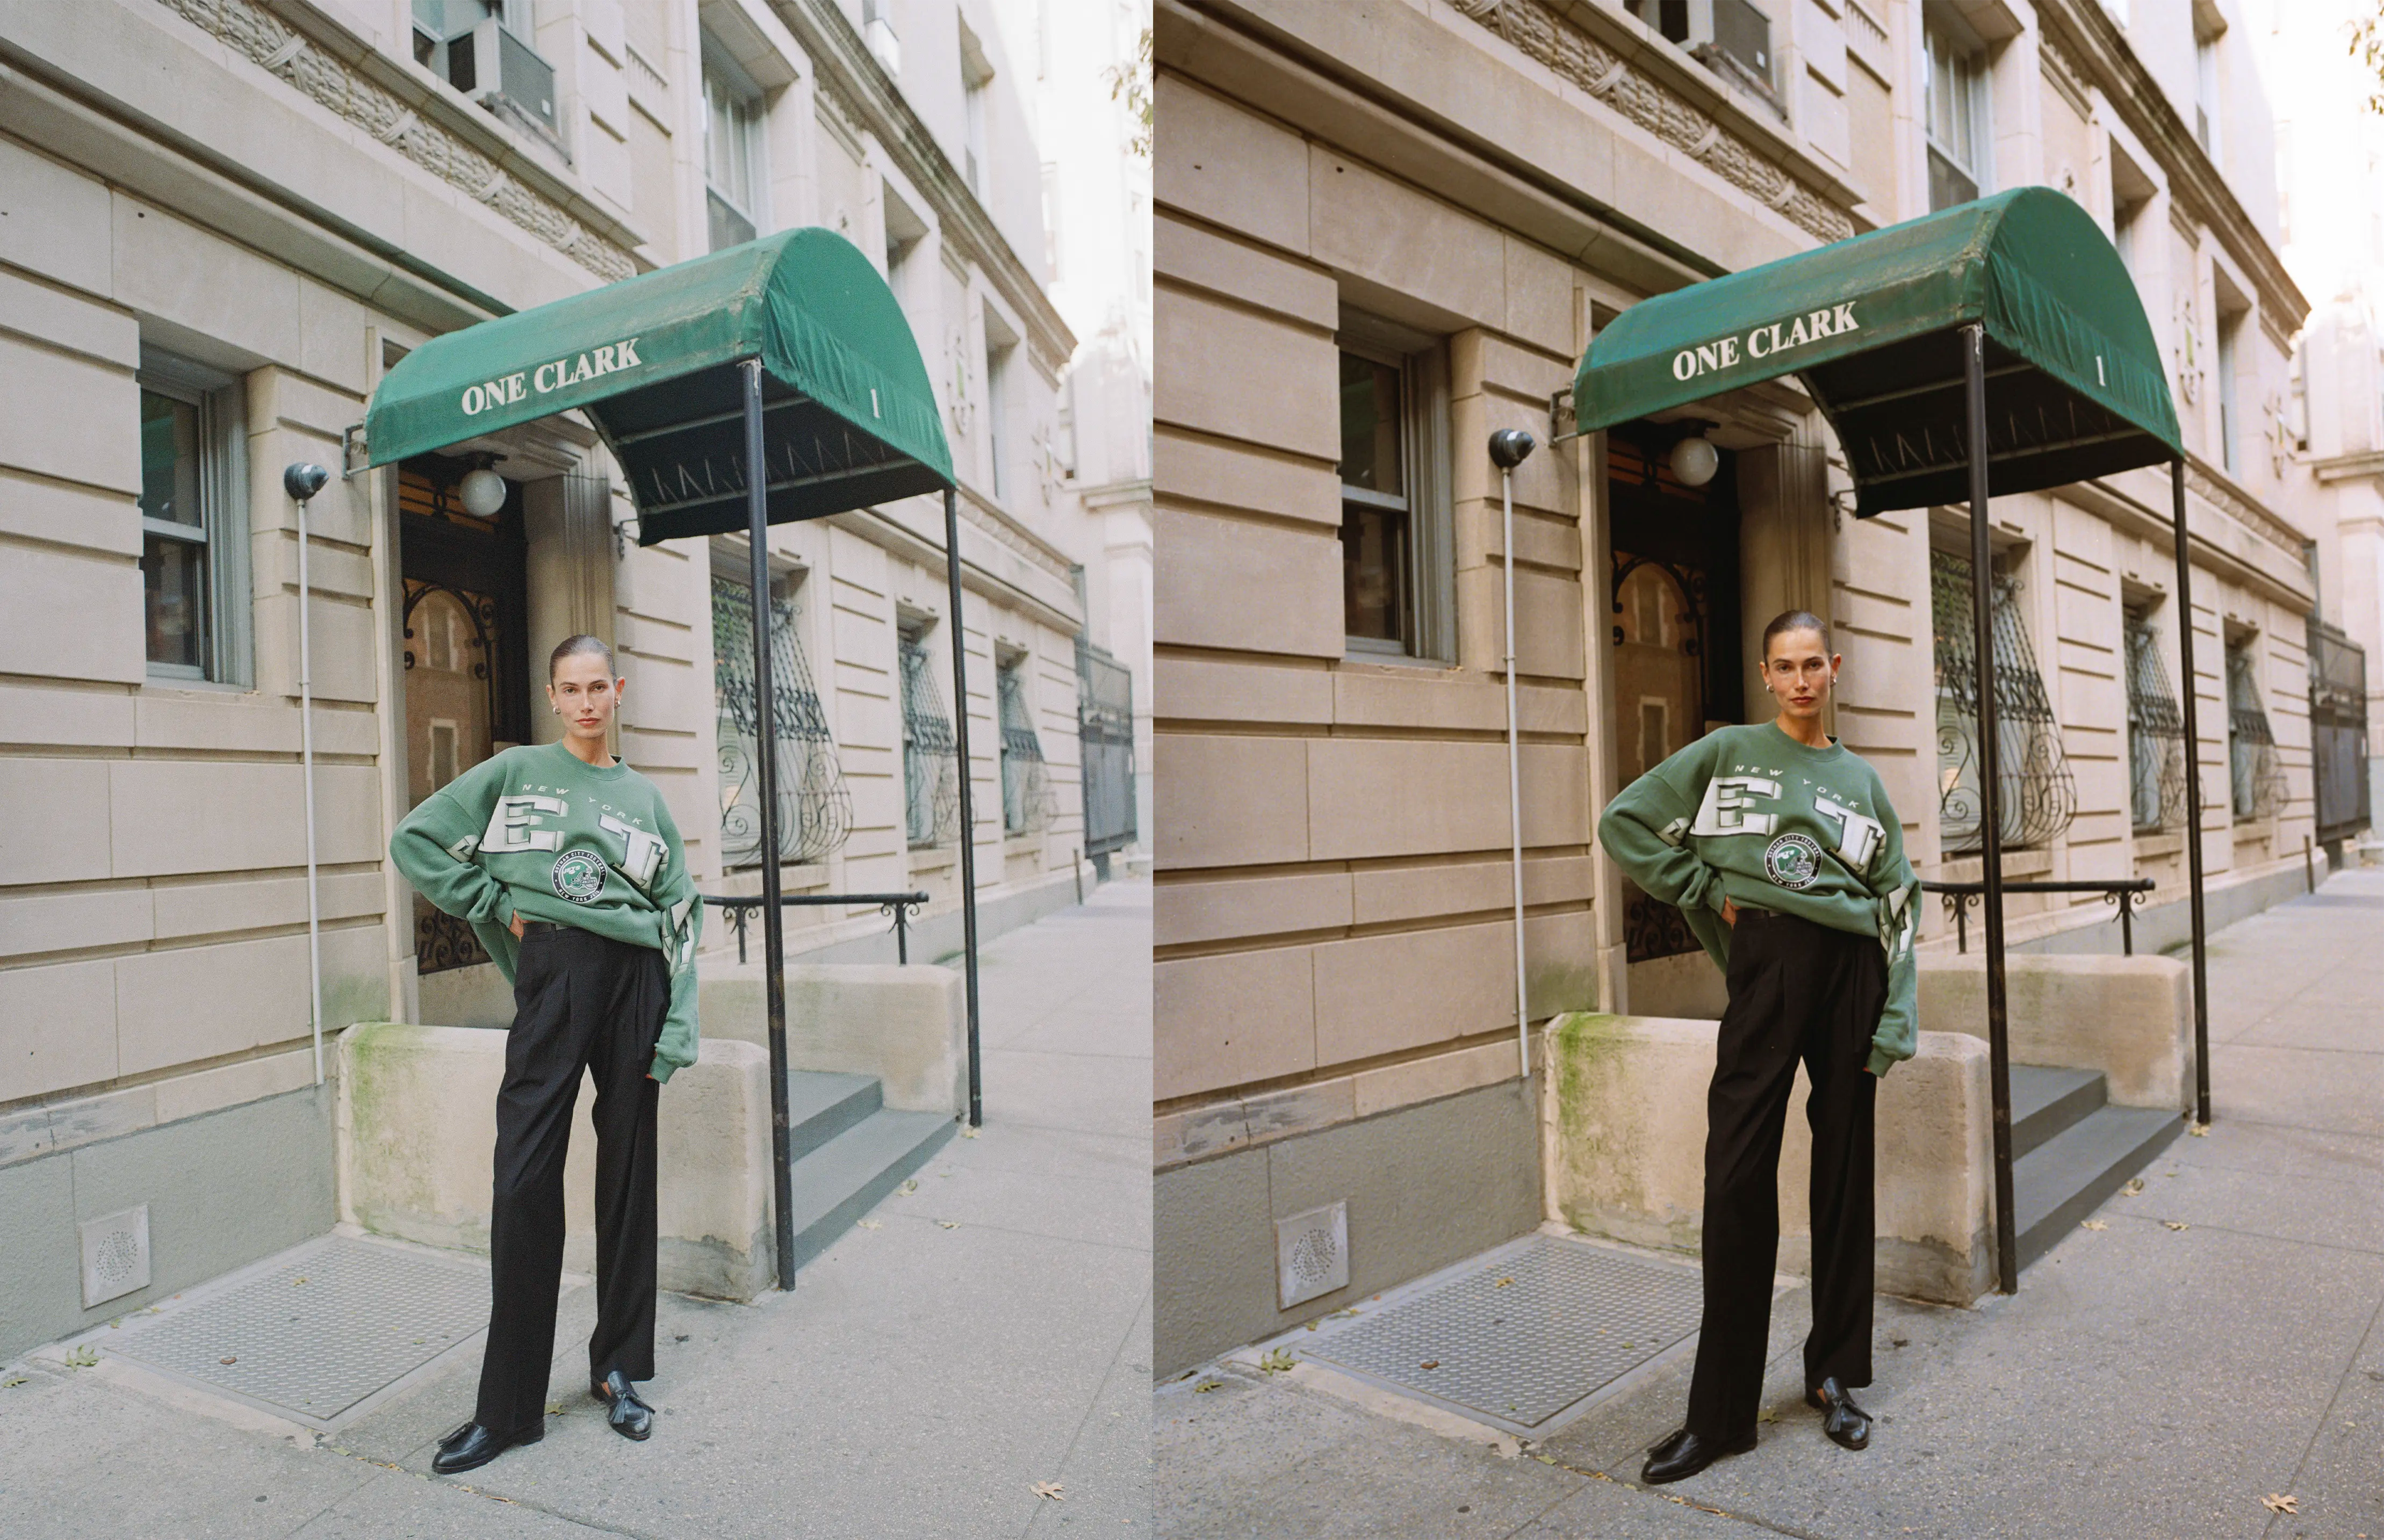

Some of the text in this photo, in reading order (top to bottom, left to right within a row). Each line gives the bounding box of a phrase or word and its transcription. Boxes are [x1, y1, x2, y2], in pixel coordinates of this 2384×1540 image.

[1673, 301, 1860, 381] ONE CLARK
[462, 337, 642, 415] ONE CLARK
[522, 784, 643, 825] NEW YORK
[1735, 765, 1860, 808] NEW YORK
[559, 889, 570, 898] NEW
